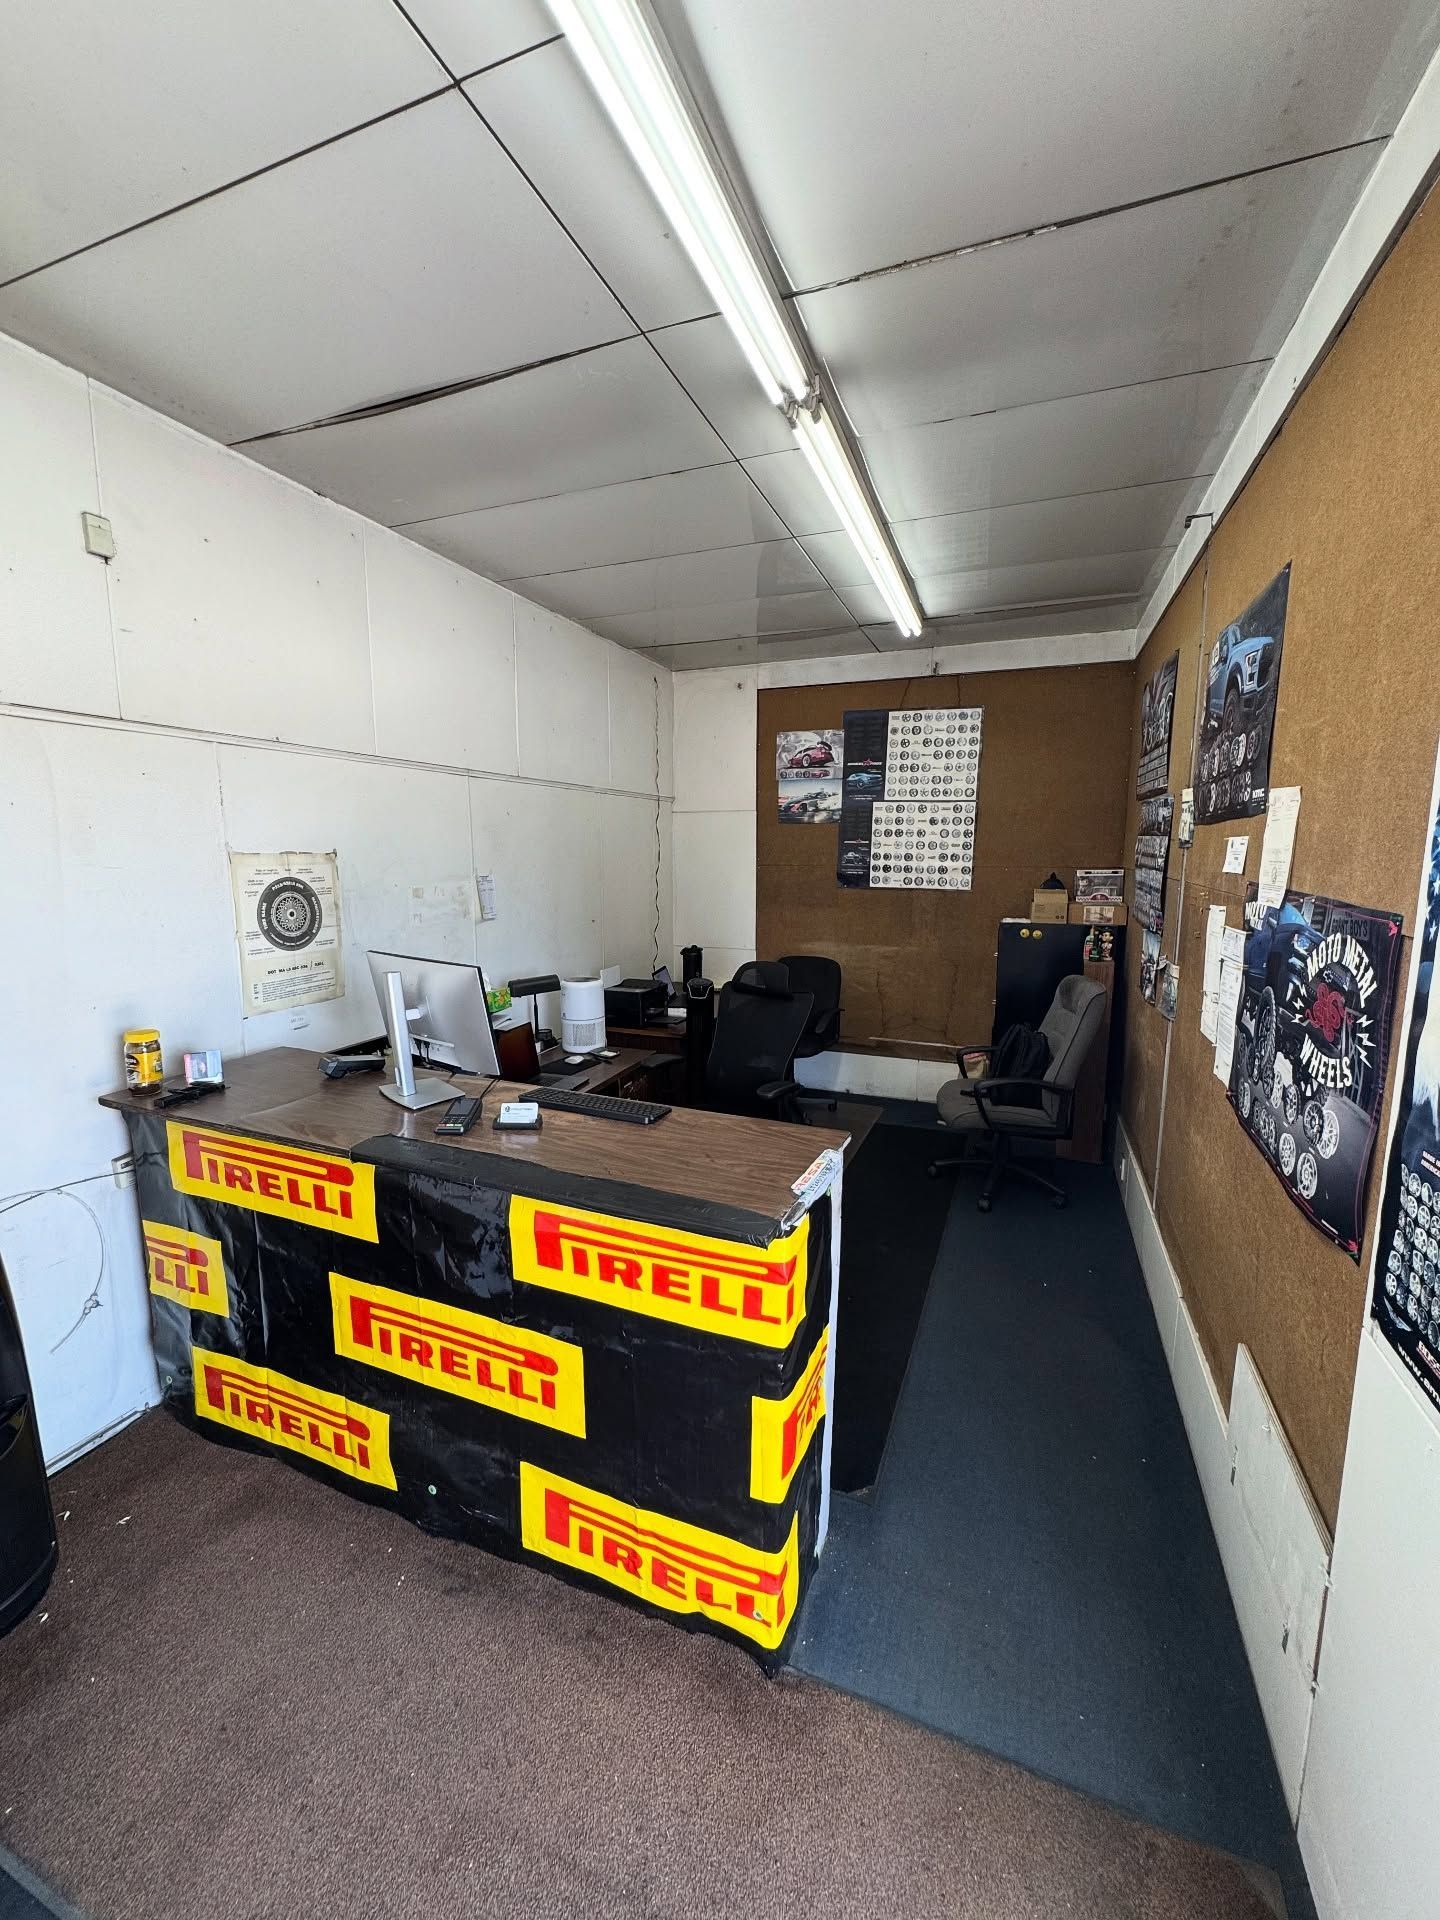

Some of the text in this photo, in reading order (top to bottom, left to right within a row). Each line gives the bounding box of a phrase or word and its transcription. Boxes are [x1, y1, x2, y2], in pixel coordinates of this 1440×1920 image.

[1252, 788, 1265, 798] KMC
[1306, 932, 1378, 1009] MOTO METAL
[1300, 1033, 1352, 1089] WHEELS
[183, 1130, 354, 1219] PIRELLI
[534, 1210, 798, 1326] PIRELLI
[350, 1296, 559, 1410] PIRELLI
[204, 1364, 371, 1470] PIRELLI
[545, 1487, 788, 1629] PIRELLI
